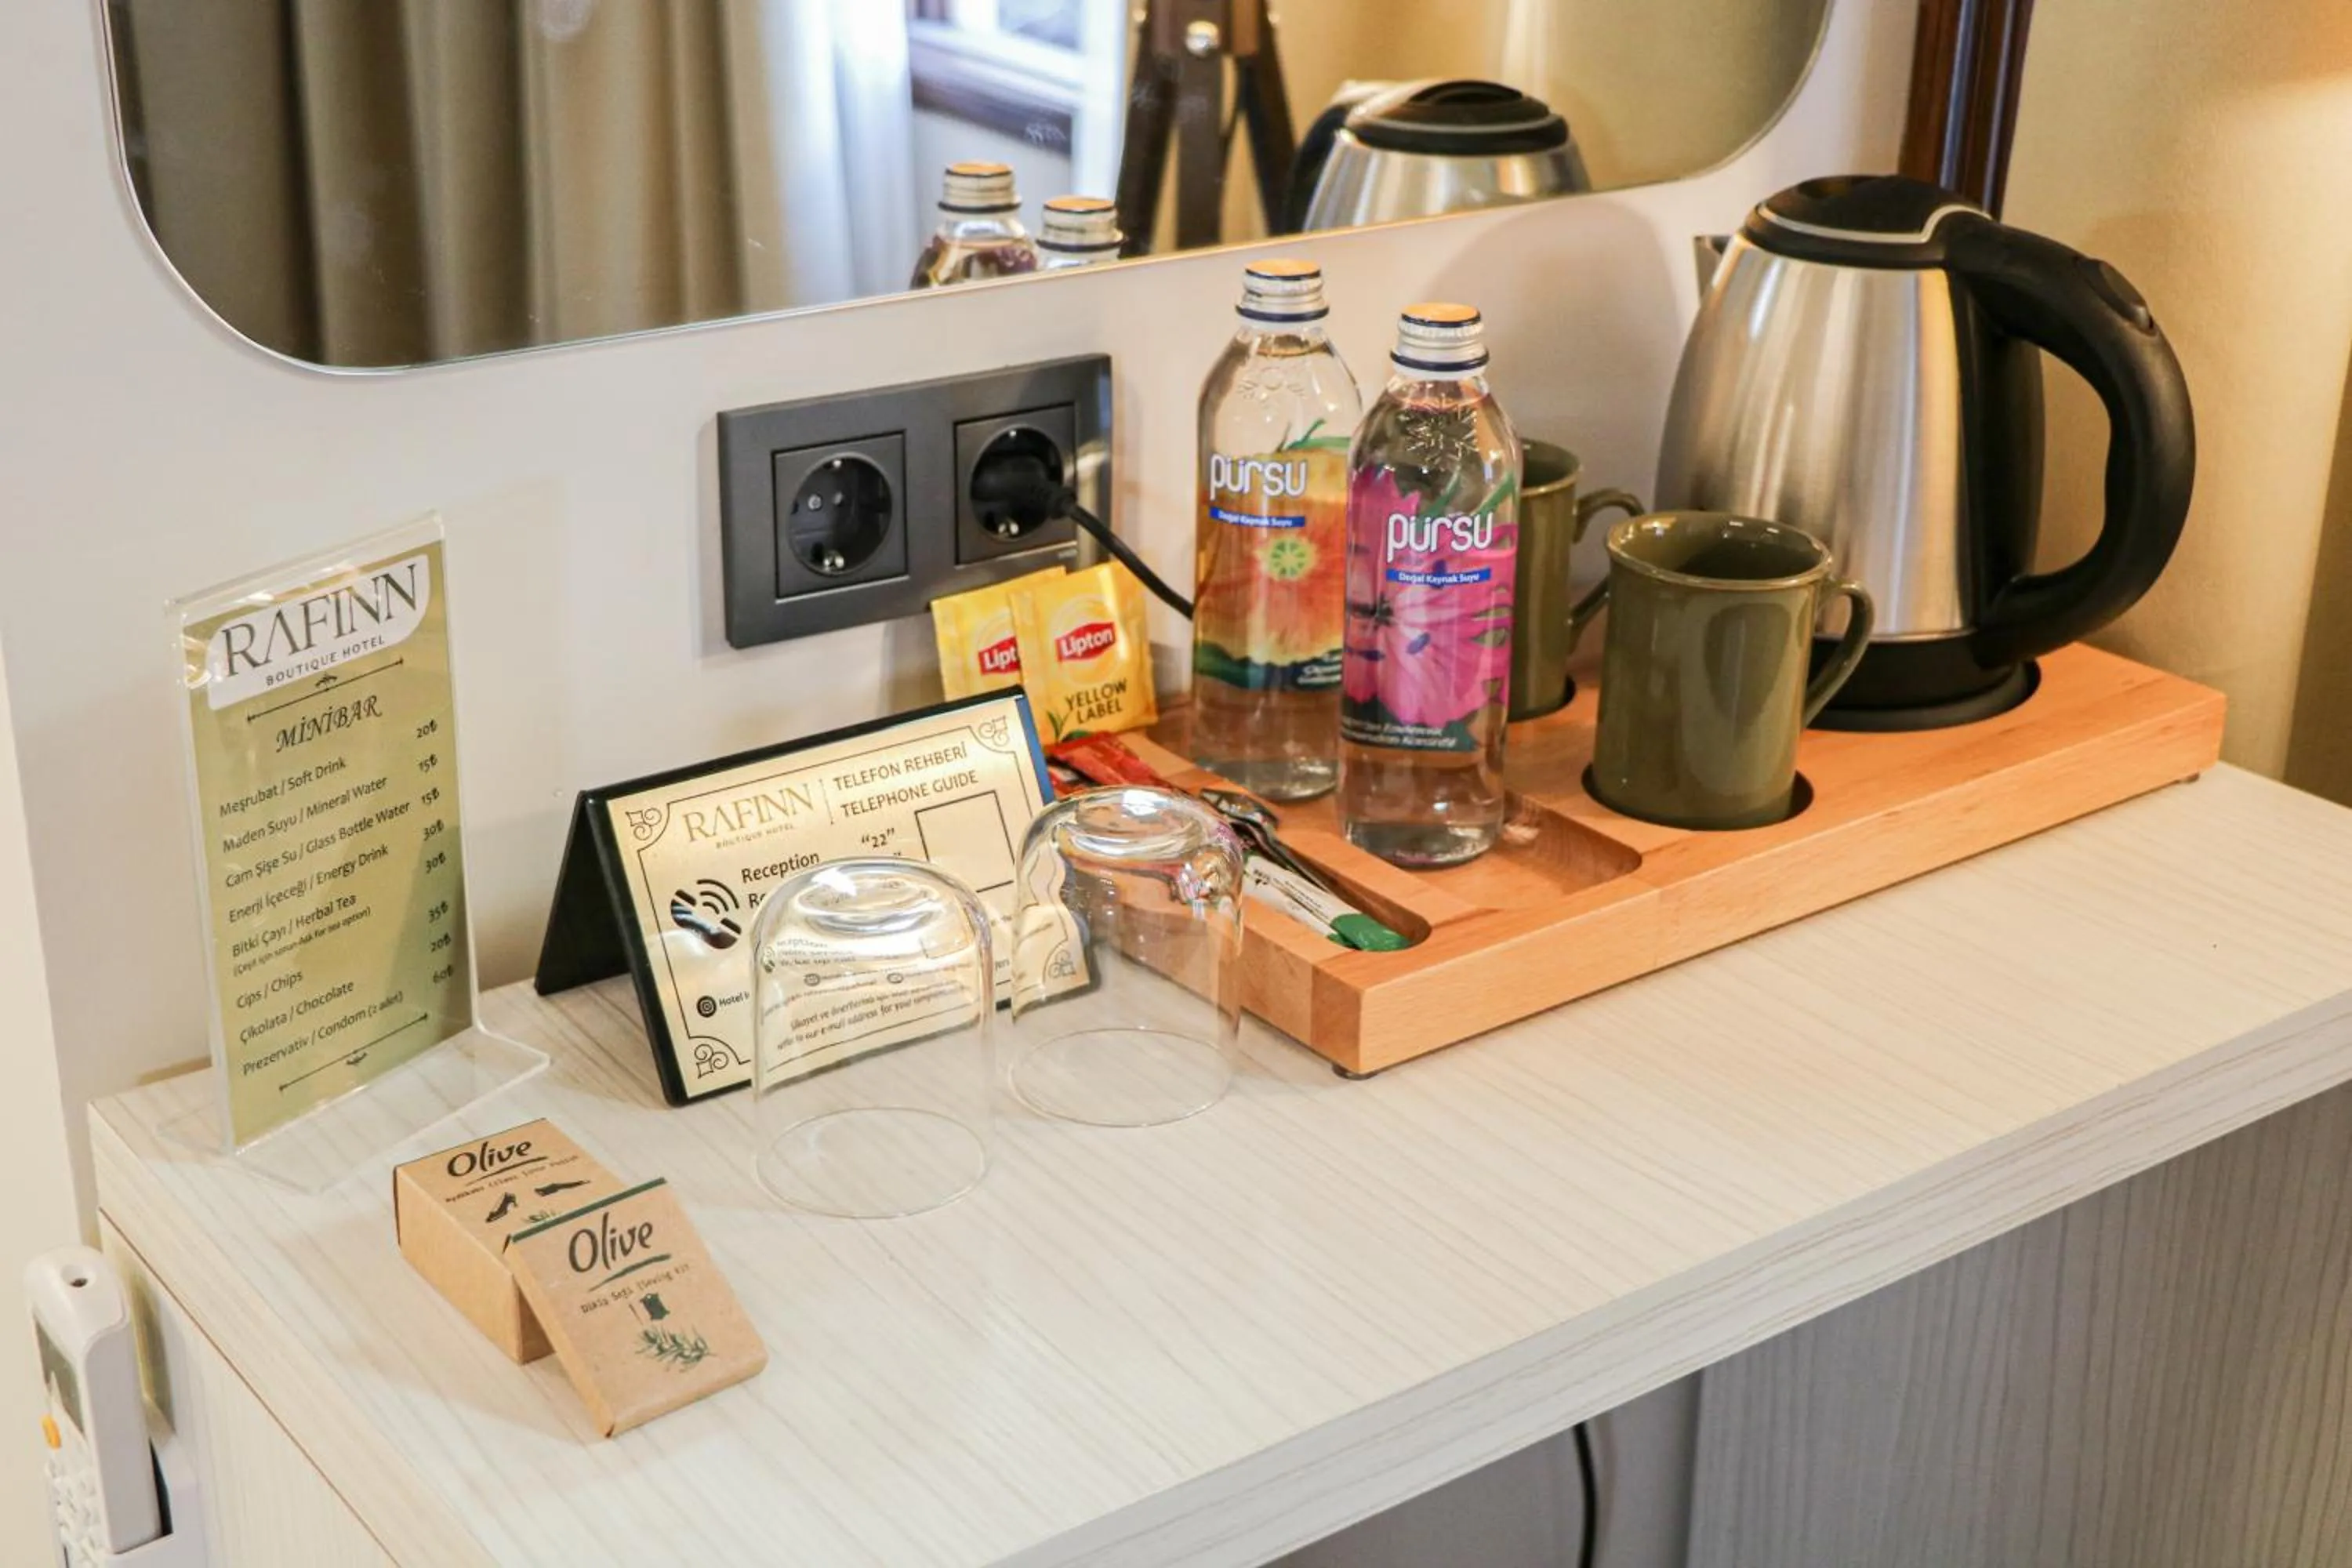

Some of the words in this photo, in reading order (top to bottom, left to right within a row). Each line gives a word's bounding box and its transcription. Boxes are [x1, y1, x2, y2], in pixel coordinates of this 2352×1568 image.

[221, 564, 417, 677] RAFINN
[1059, 628, 1112, 657] Lipton
[266, 652, 337, 686] BOUTIQUE
[342, 634, 386, 659] HOTEL
[1065, 677, 1127, 708] YELLOW
[1076, 700, 1123, 724] LABEL
[220, 785, 278, 817] Meşrubat
[288, 770, 313, 790] Soft
[316, 757, 346, 779] Drink
[833, 762, 901, 791] TELEFON
[905, 741, 967, 772] REHBERİ
[840, 784, 930, 818] TELEPHONE
[933, 770, 979, 793] GUIDE
[223, 826, 266, 853] Maden
[267, 815, 297, 835] Suyu
[307, 790, 350, 817] Mineral
[352, 777, 387, 798] Water
[682, 783, 816, 843] RAFINN
[226, 869, 252, 887] Cam
[256, 858, 279, 878] Şişe
[282, 849, 297, 865] Su
[307, 835, 336, 854] Glass
[339, 816, 373, 840] Bottle
[376, 802, 410, 823] Water
[742, 851, 820, 884] Reception
[230, 899, 263, 923] Enerji
[316, 861, 357, 885] Energy
[359, 844, 388, 866] Drink
[232, 934, 259, 957] Bitki
[296, 902, 333, 928] Herbal
[336, 895, 357, 911] Tea
[237, 990, 262, 1008] Cips
[271, 971, 303, 993] Chips
[240, 1013, 287, 1045] Çikolata
[296, 982, 354, 1015] Chocolate
[243, 1036, 309, 1076] Prezervativ
[318, 1009, 366, 1040] Condom
[447, 1140, 532, 1177] Olive
[568, 1212, 654, 1273] Olive
